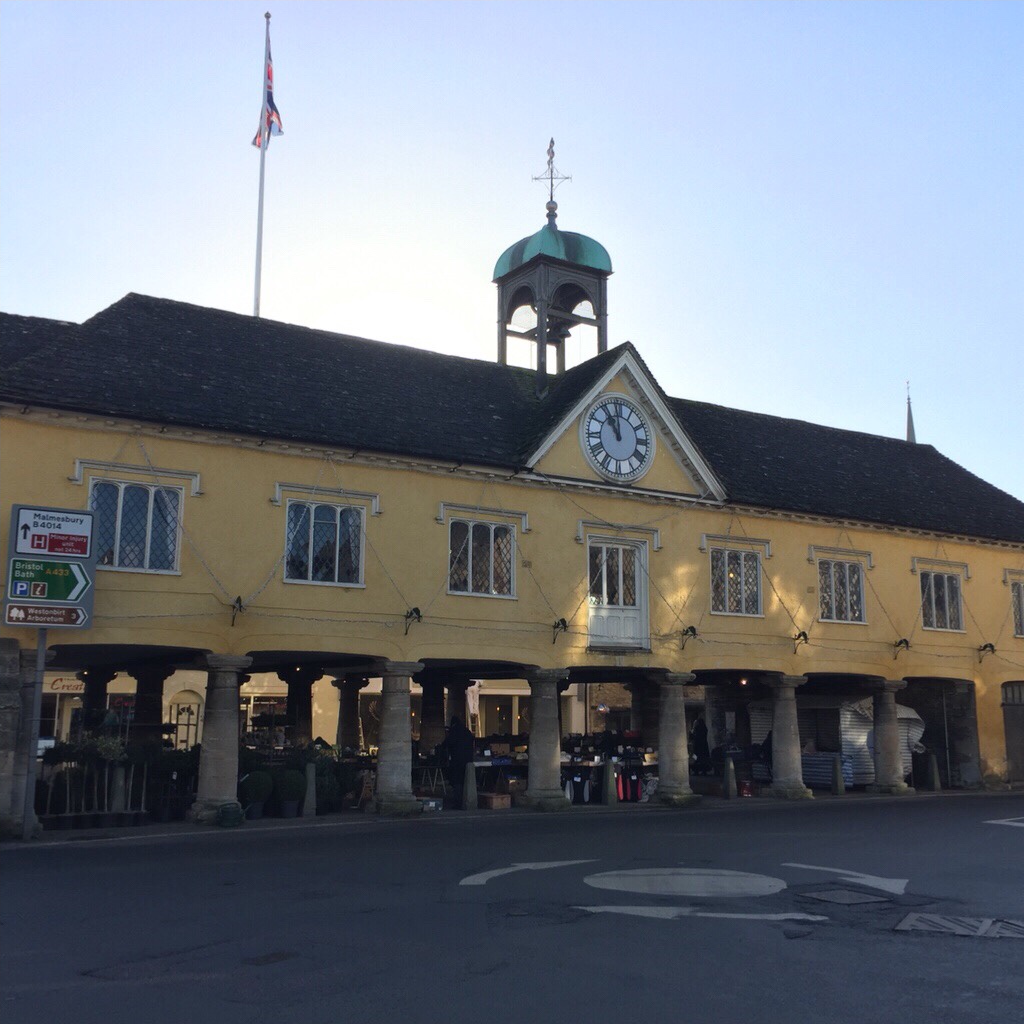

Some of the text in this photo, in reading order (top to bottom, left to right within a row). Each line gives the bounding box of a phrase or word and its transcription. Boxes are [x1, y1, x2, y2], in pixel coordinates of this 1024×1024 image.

[33, 513, 84, 525] Malmesbury
[33, 536, 45, 548] H
[15, 562, 44, 571] Bristol
[14, 570, 35, 578] Bath
[45, 568, 70, 576] A433
[16, 582, 27, 595] P
[27, 608, 66, 616] Westonbirt
